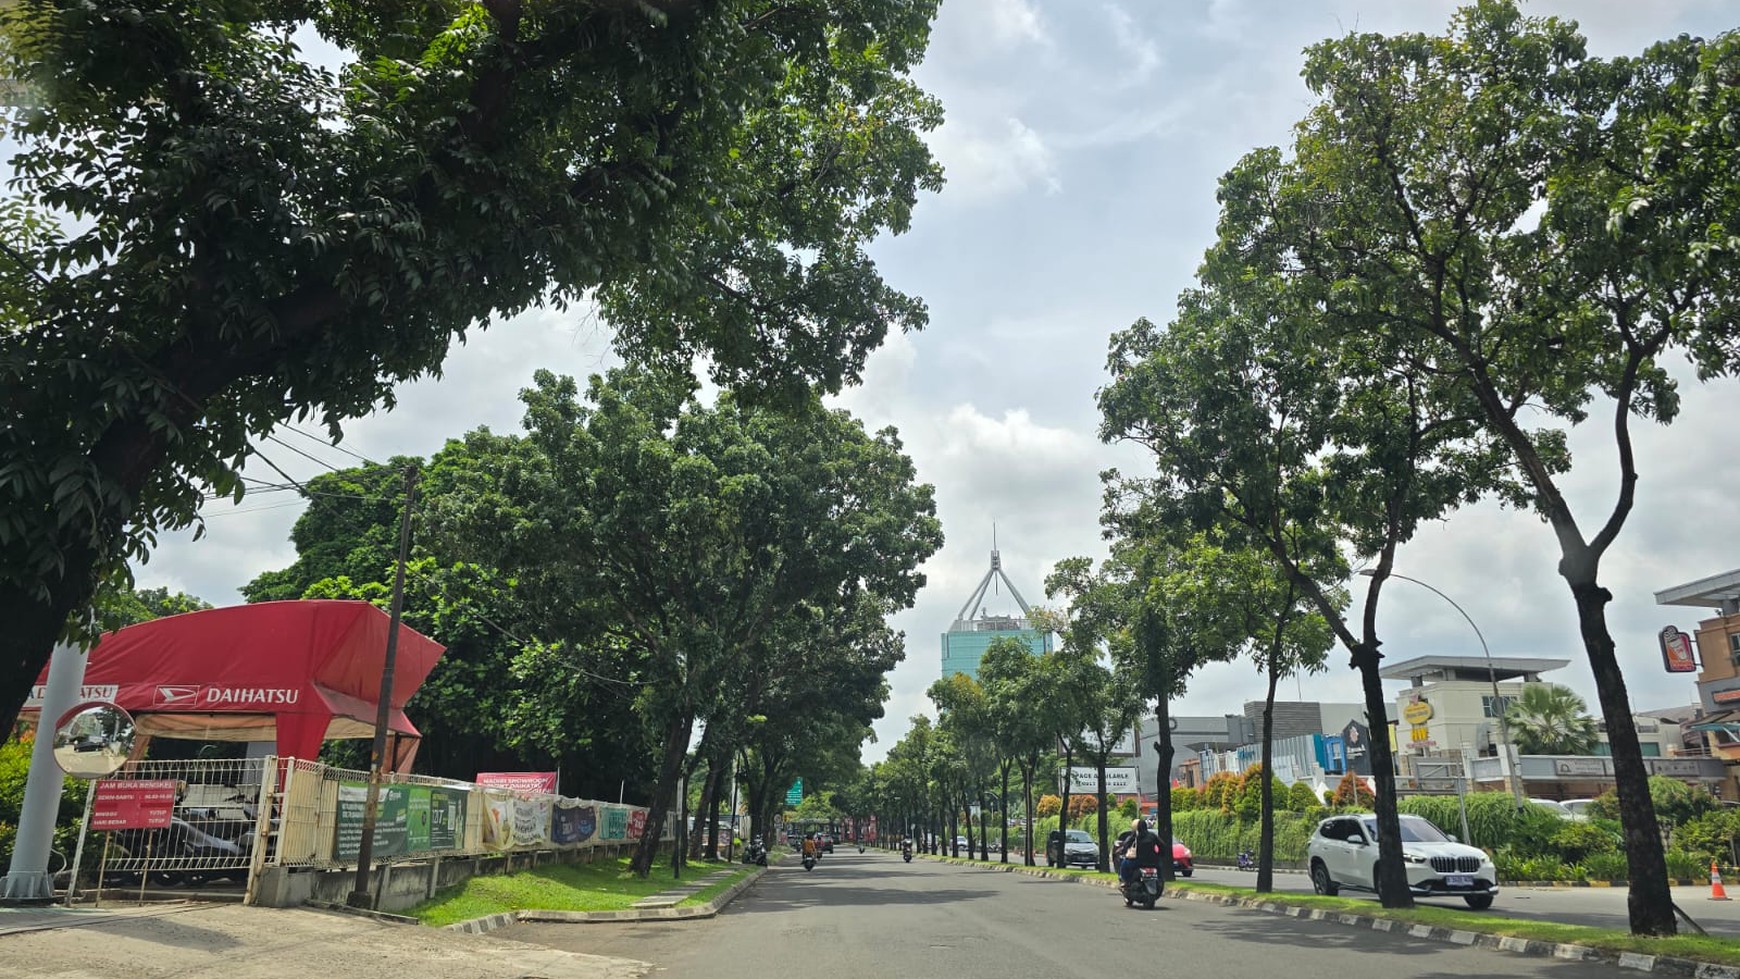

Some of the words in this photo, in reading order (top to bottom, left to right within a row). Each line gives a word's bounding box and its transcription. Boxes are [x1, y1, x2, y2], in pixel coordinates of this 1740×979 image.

[206, 687, 299, 704] DAIHATSU
[116, 781, 138, 789] BUKA
[139, 781, 173, 789] BENGKEL
